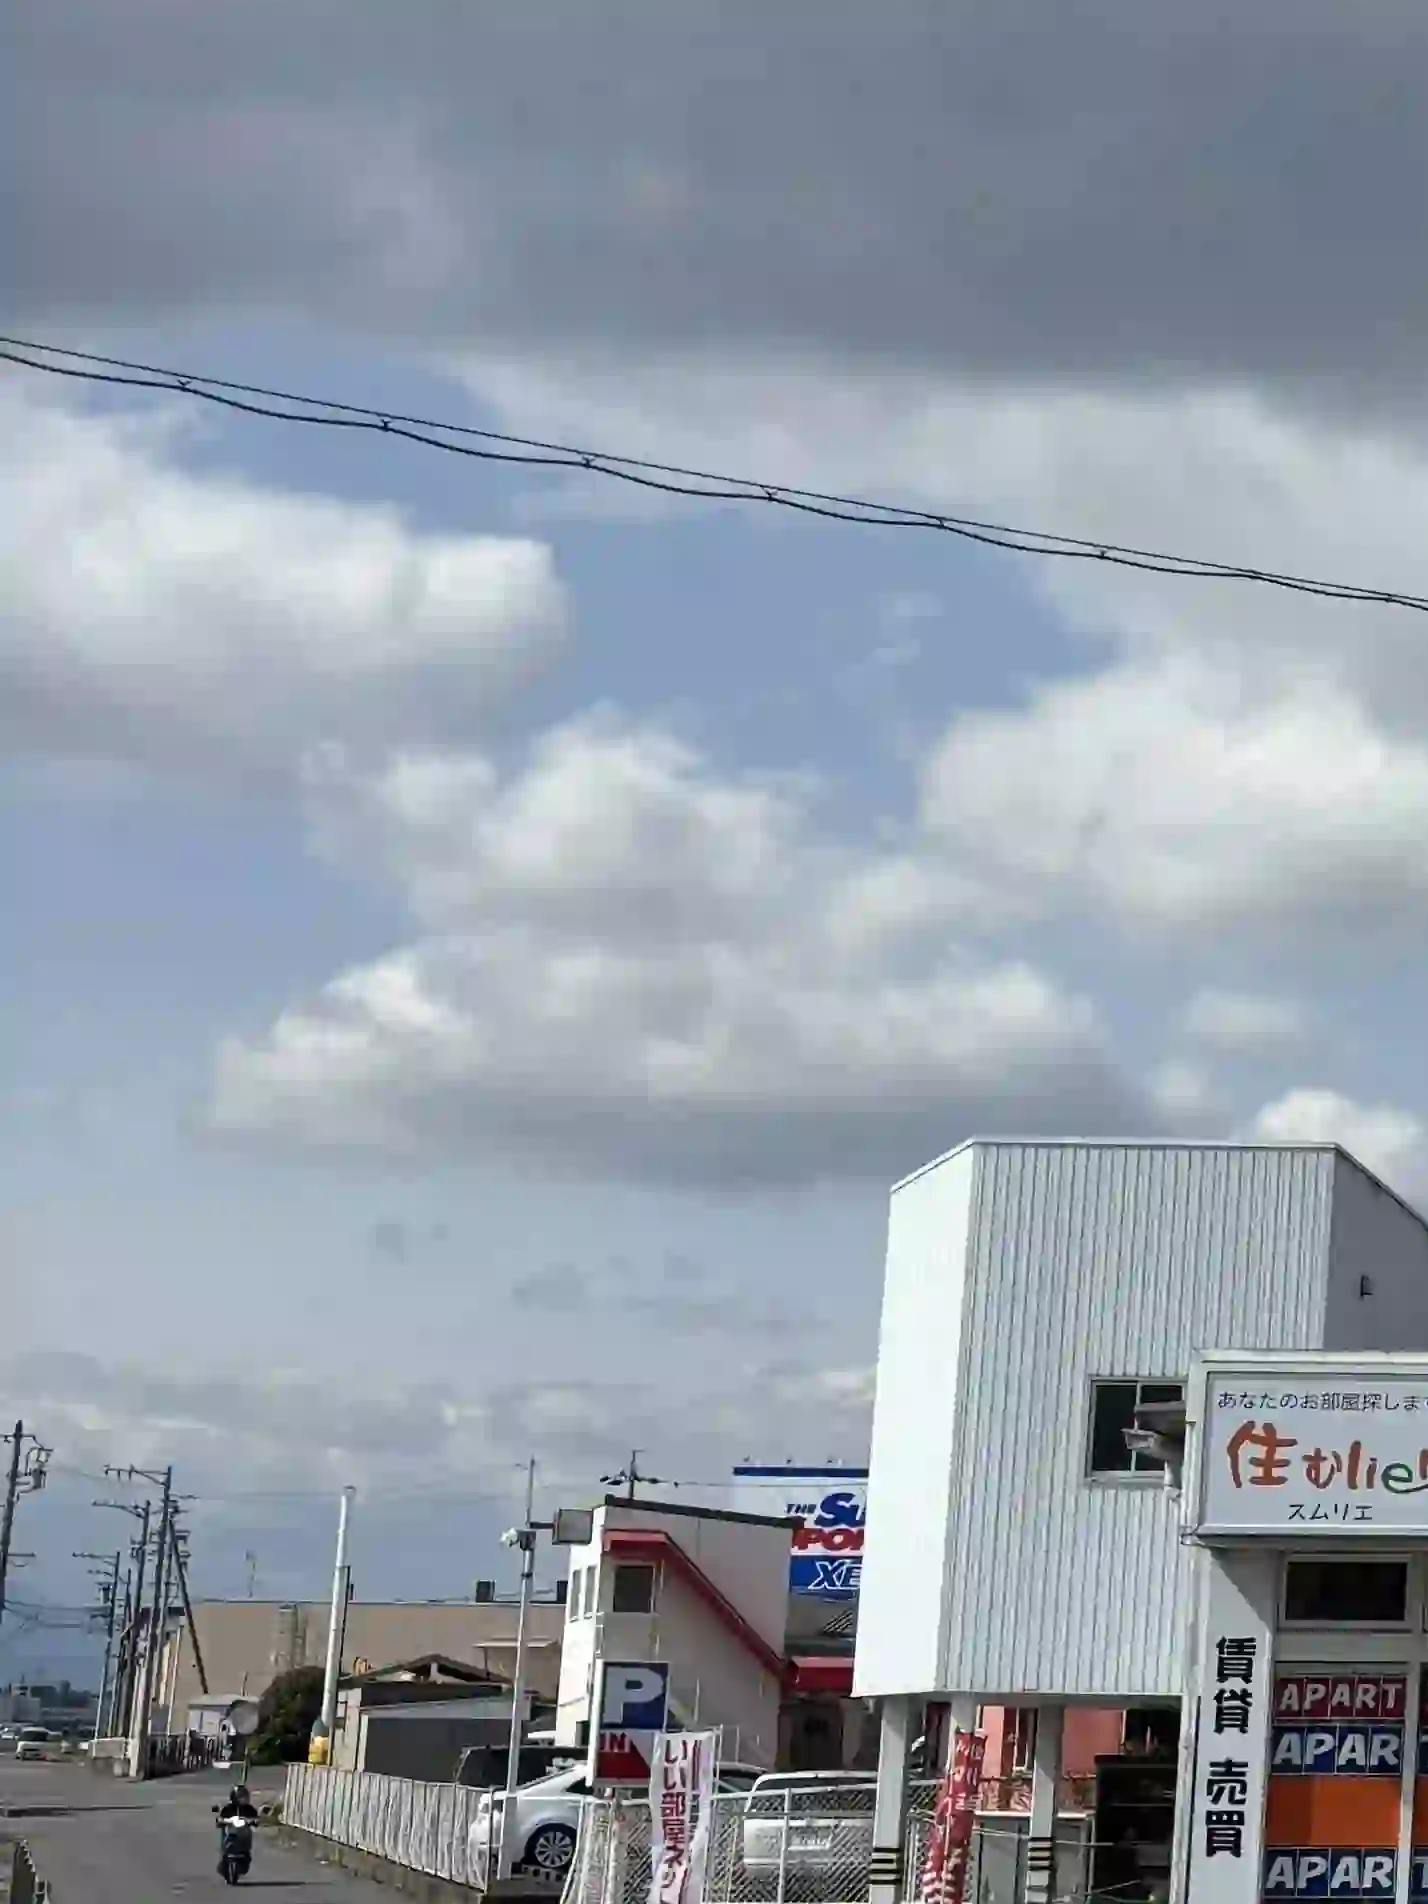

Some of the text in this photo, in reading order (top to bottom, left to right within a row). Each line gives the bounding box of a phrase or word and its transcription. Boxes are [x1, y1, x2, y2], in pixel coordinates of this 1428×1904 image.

[1288, 1503, 1373, 1522] スムリエ
[604, 1666, 664, 1724] P
[1205, 1636, 1256, 1858] 賃貸 売買
